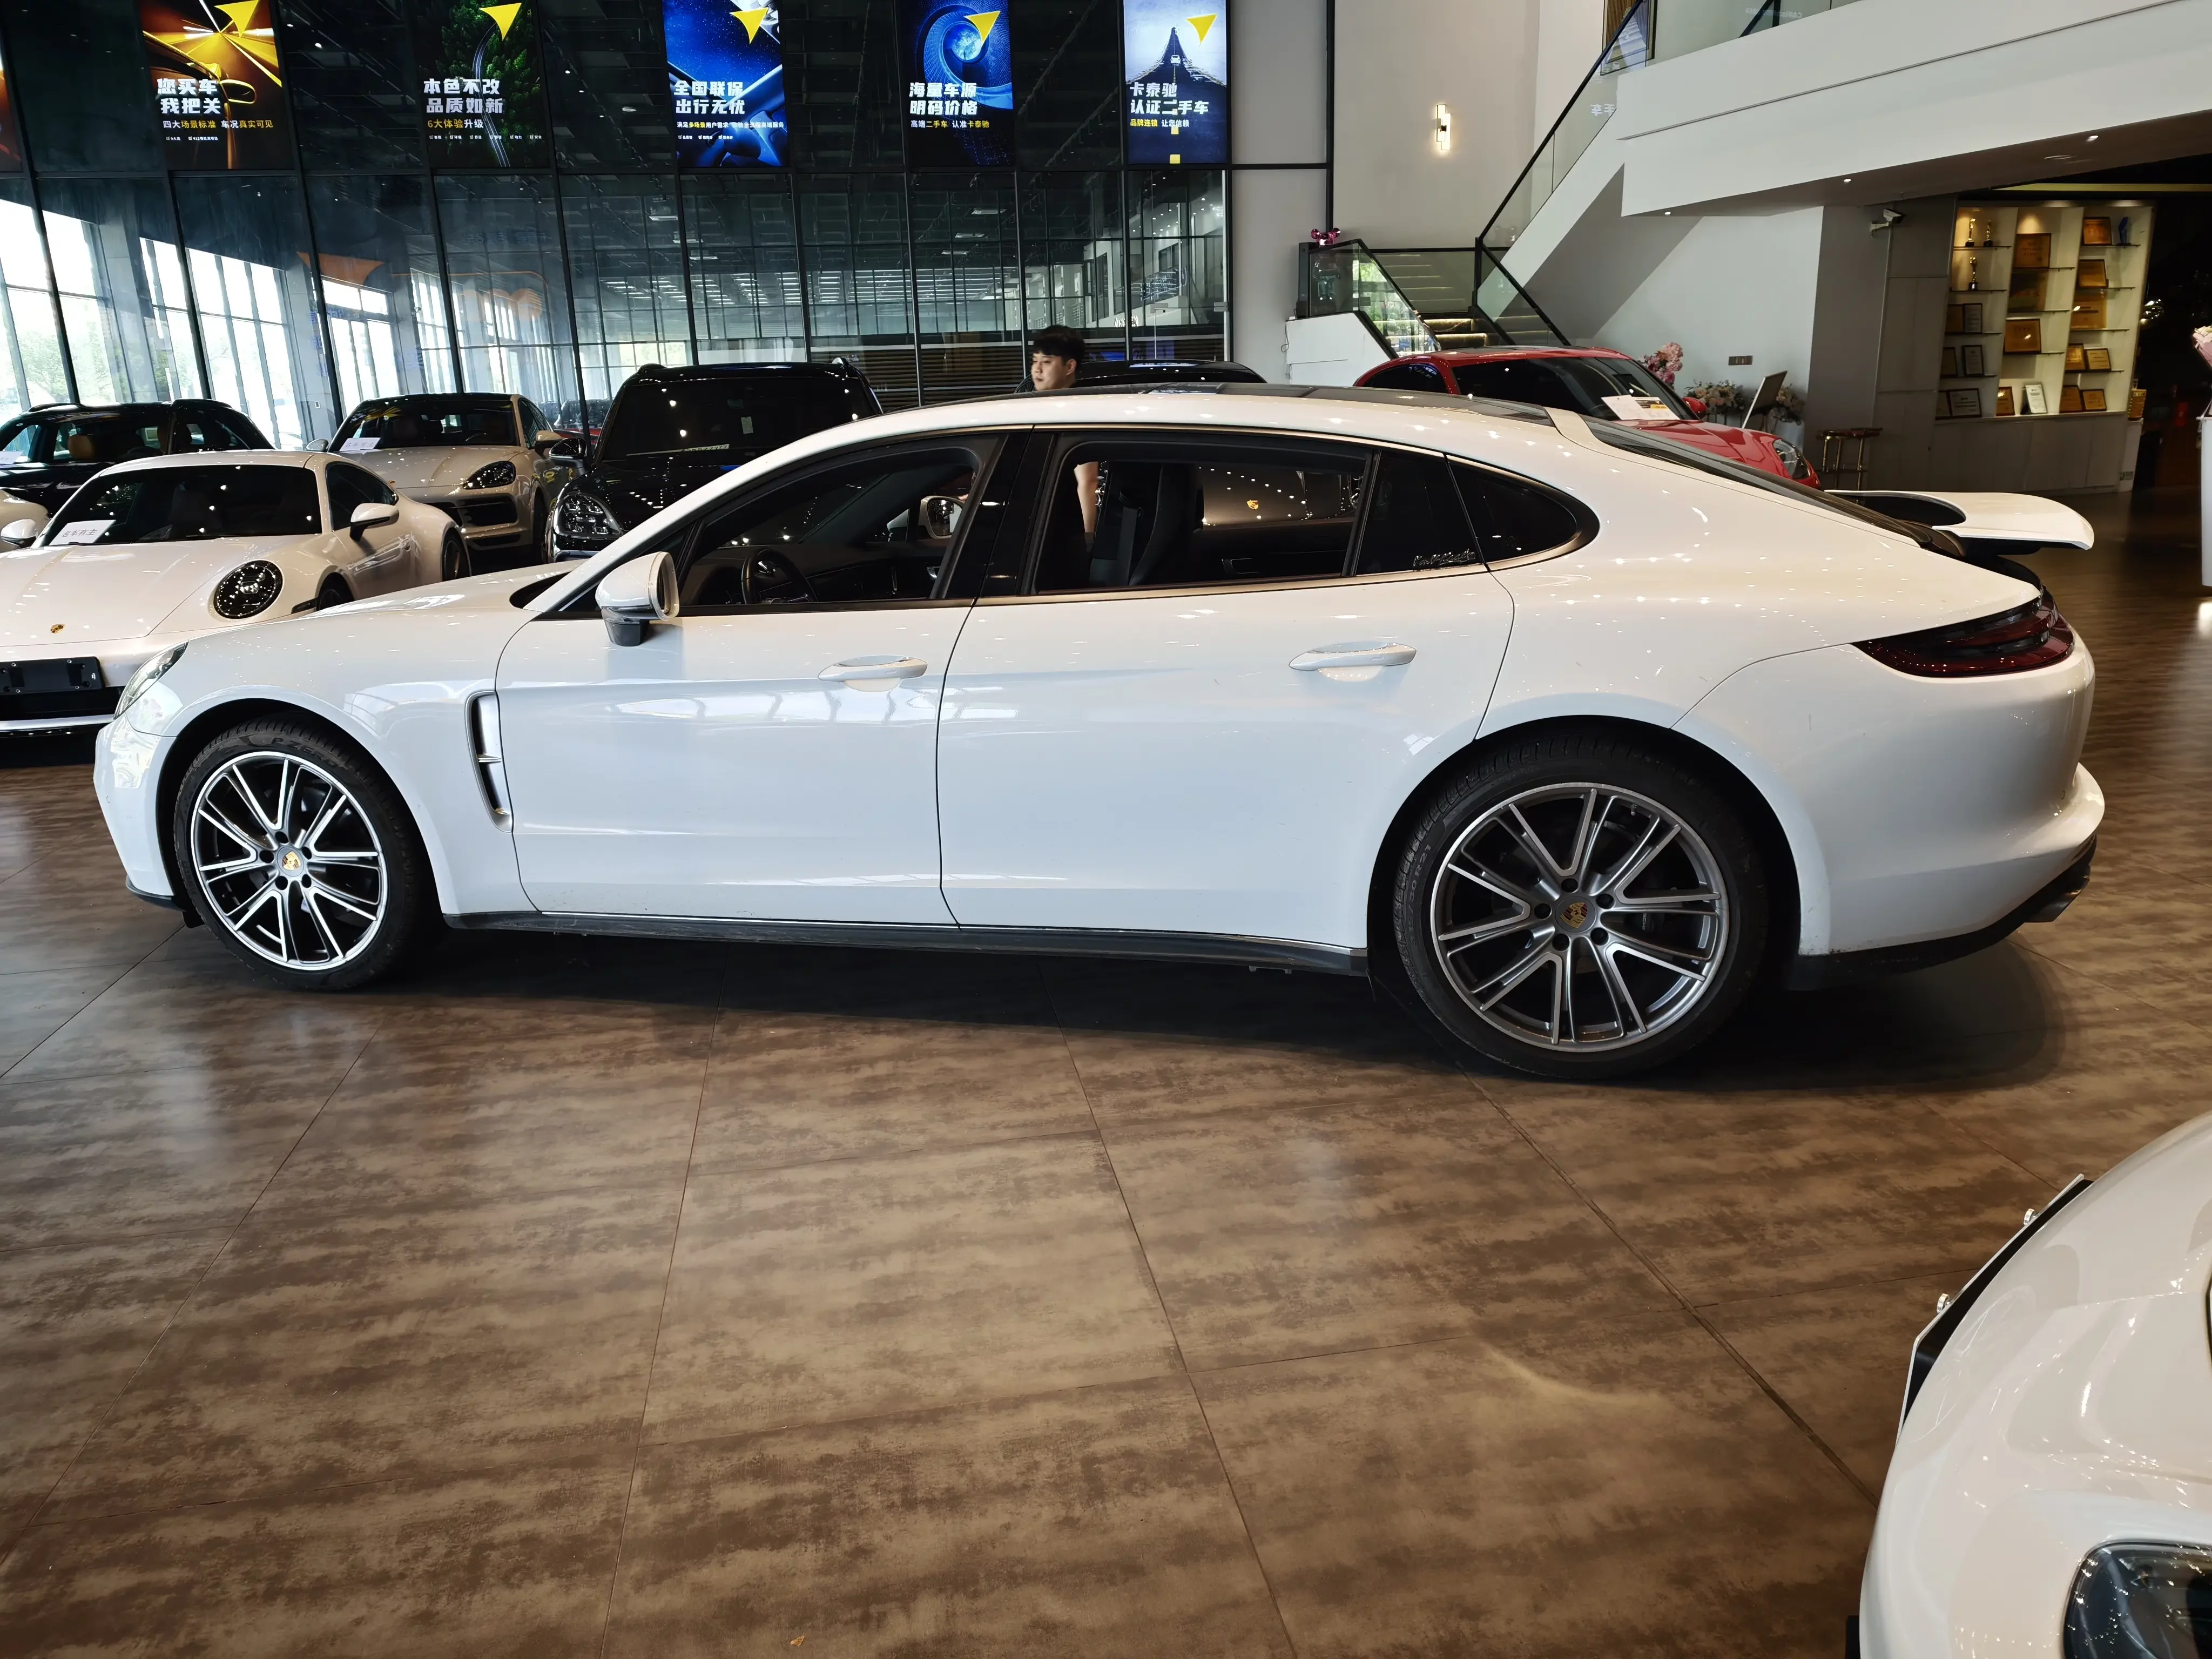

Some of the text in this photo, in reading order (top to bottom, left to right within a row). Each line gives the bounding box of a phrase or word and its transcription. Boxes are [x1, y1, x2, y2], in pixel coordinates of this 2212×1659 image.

[157, 78, 217, 95] 您买车
[423, 78, 500, 95] 本色不改
[674, 80, 744, 97] 全国联保
[909, 82, 977, 97] 海量车源
[1130, 82, 1177, 97] 卡泰驰
[160, 98, 221, 114] 我把关
[426, 98, 503, 113] 品质如新
[676, 99, 745, 114] 出行无忧
[910, 100, 977, 115] 明码价格
[1130, 99, 1209, 115] 认证二手车
[163, 120, 273, 129] 四大场景标准 车况真实可见
[427, 119, 484, 129] 6大体验升级
[911, 120, 989, 129] 高端二手车 认准卡泰驰
[1130, 119, 1158, 127] 品牌连锁
